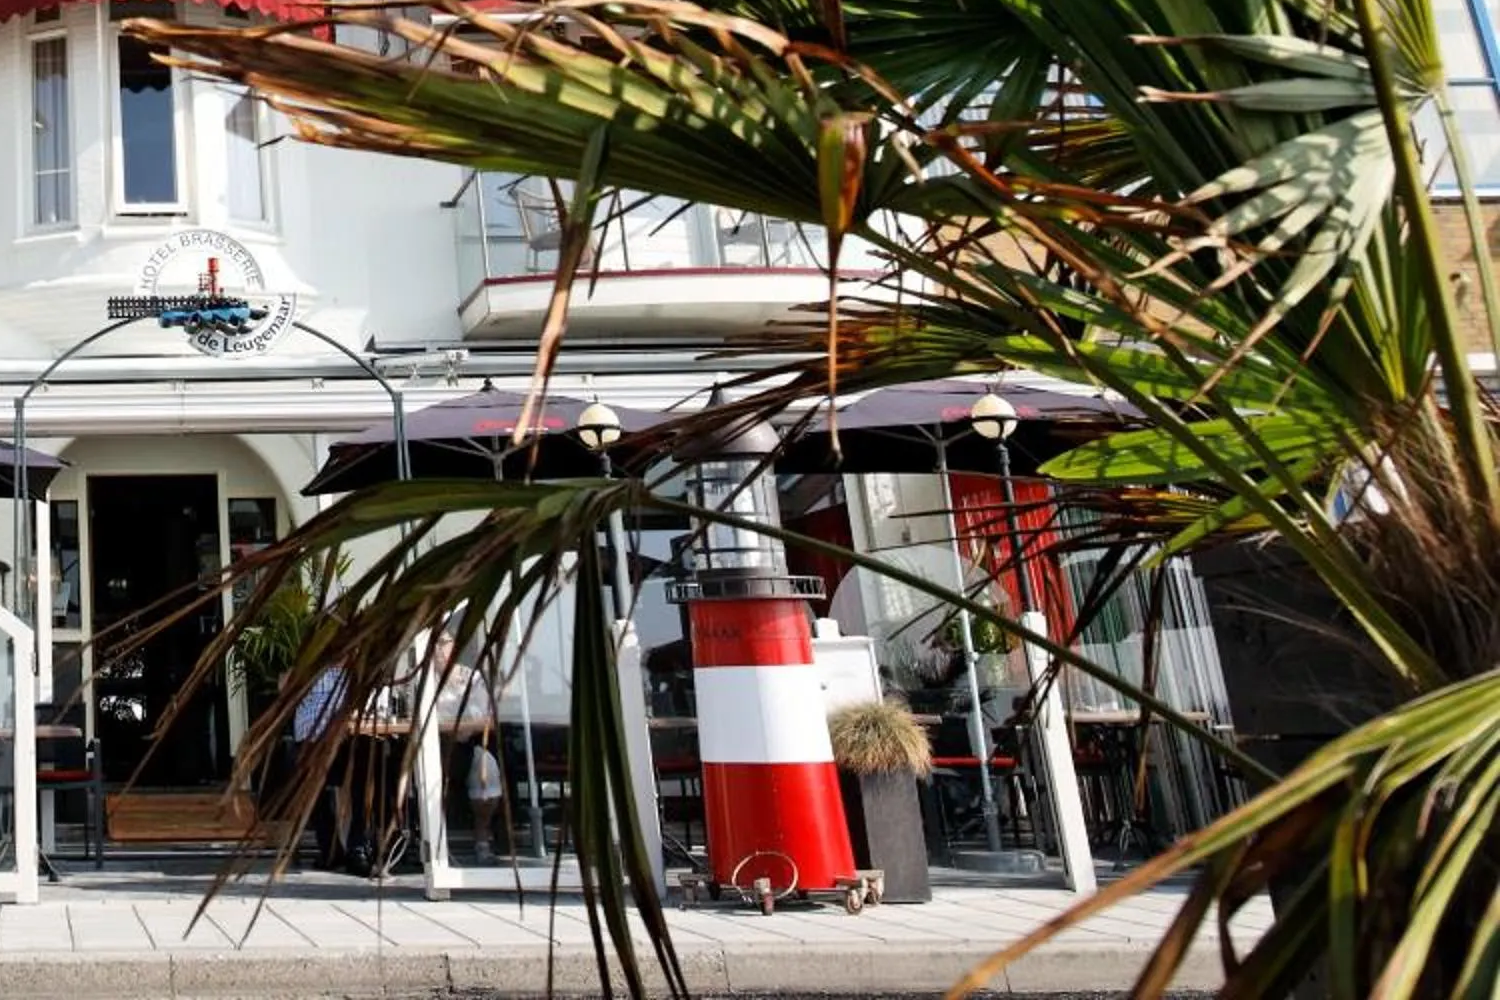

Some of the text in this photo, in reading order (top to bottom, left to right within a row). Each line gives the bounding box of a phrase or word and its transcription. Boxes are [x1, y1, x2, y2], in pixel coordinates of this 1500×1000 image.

[140, 232, 259, 289] HOTEL BRASSERIE
[197, 296, 293, 353] de Leugenaar
